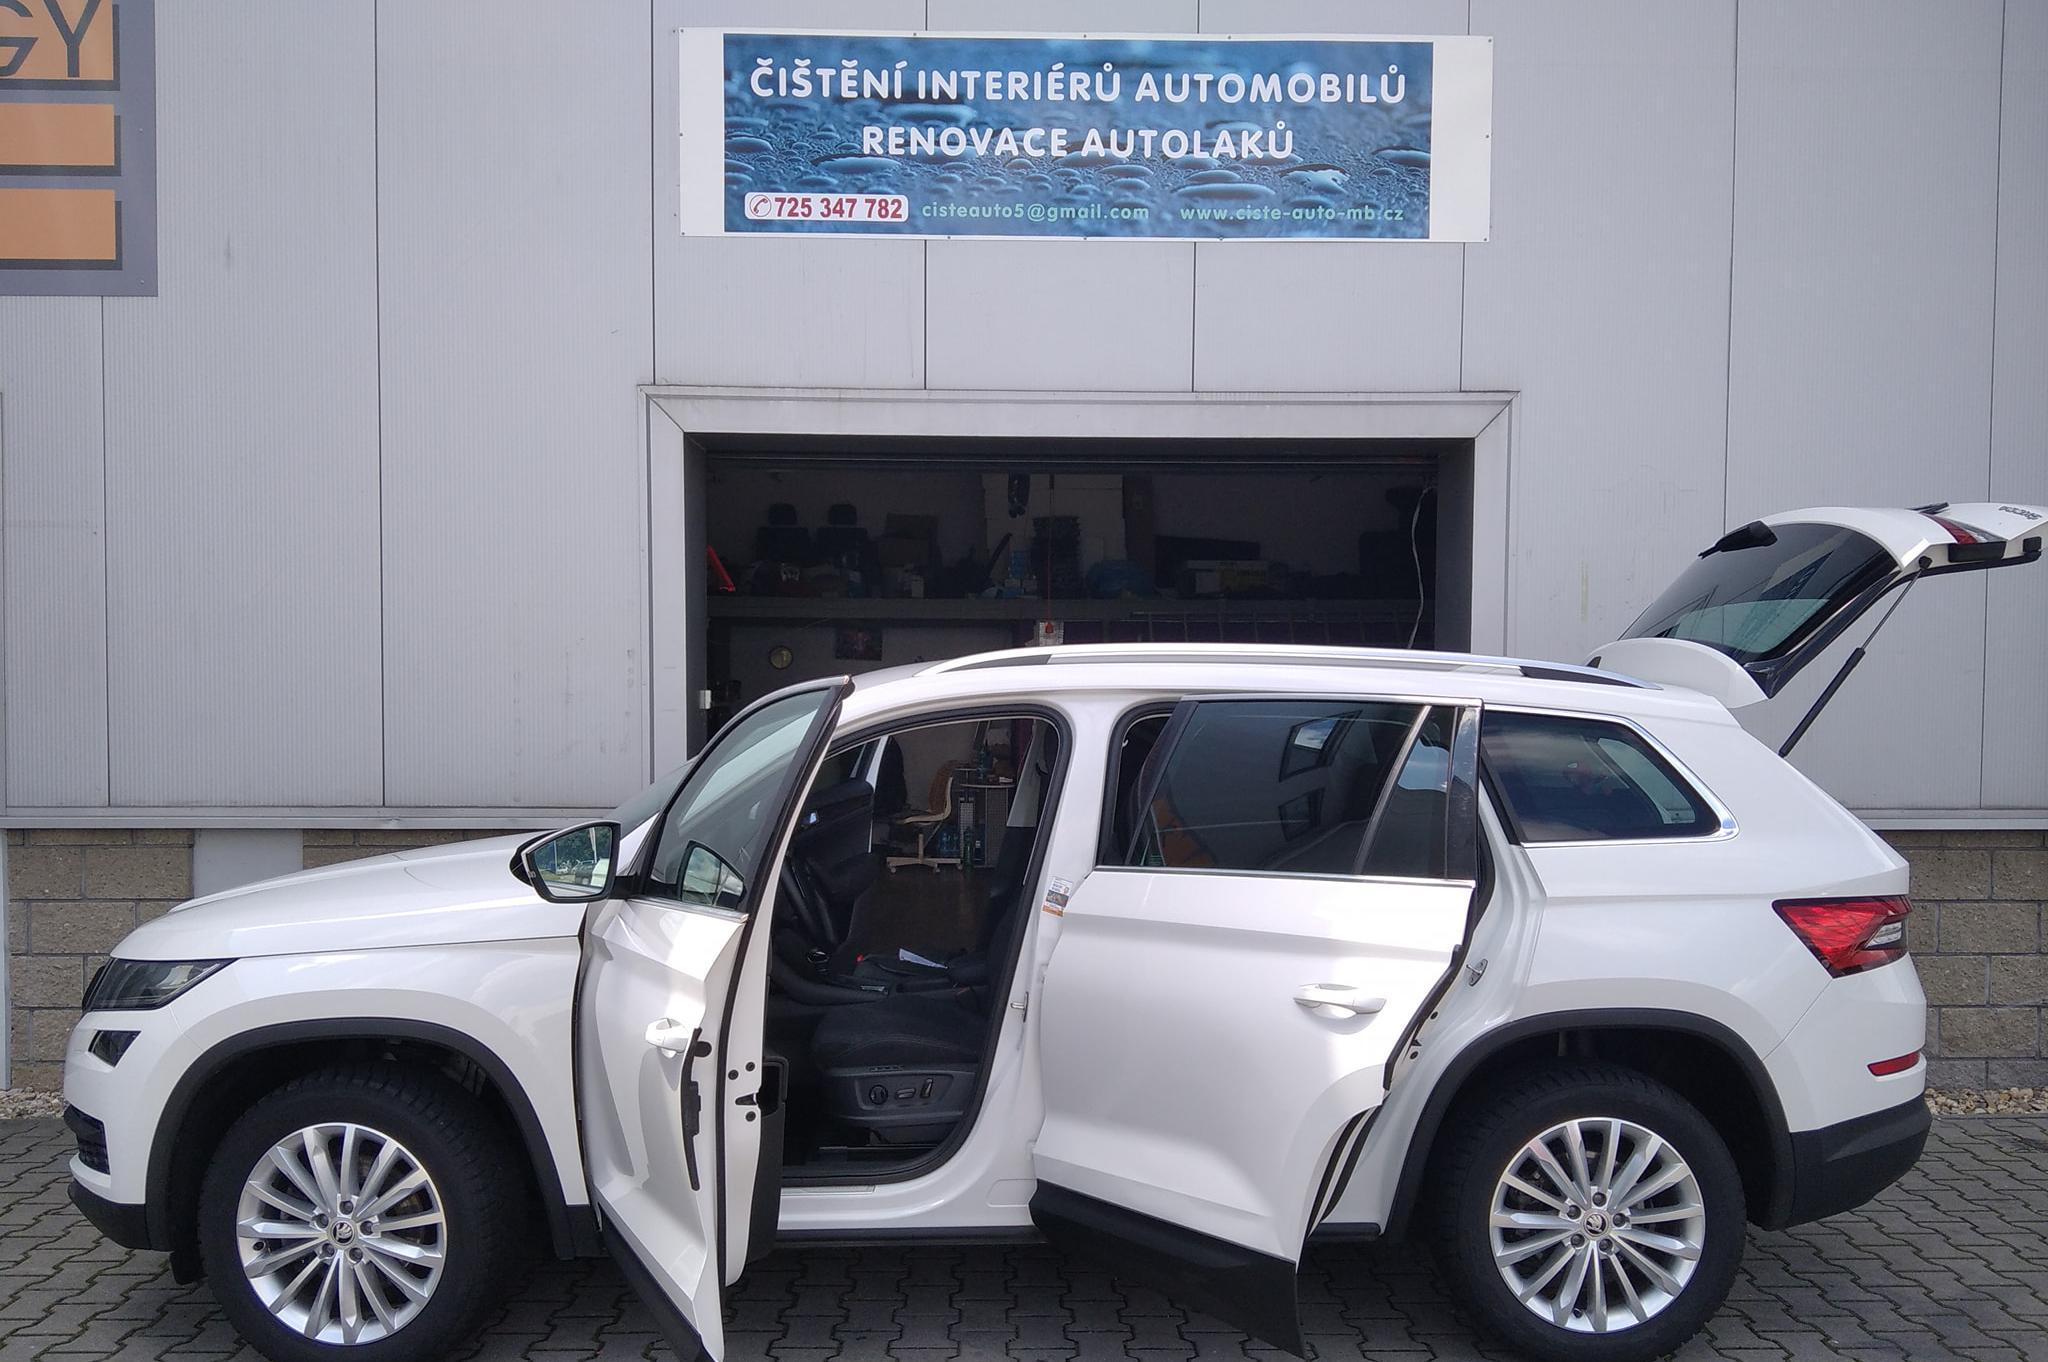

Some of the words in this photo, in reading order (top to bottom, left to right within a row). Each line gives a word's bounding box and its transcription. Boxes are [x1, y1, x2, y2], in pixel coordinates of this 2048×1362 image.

[750, 57, 908, 99] ČIŠTĚNÍ
[917, 62, 1121, 102] INTERIÉRŮ
[1134, 64, 1406, 104] AUTOMOBILŮ
[862, 126, 1068, 158] RENOVACE
[1080, 120, 1294, 160] AUTOLAKŮ
[774, 196, 813, 218] 725
[820, 197, 858, 218] 347
[864, 198, 903, 219] 782
[921, 201, 1150, 223] cisteauto5@gmail.com
[1180, 204, 1405, 222] www.ciste-auto-mb.cz
